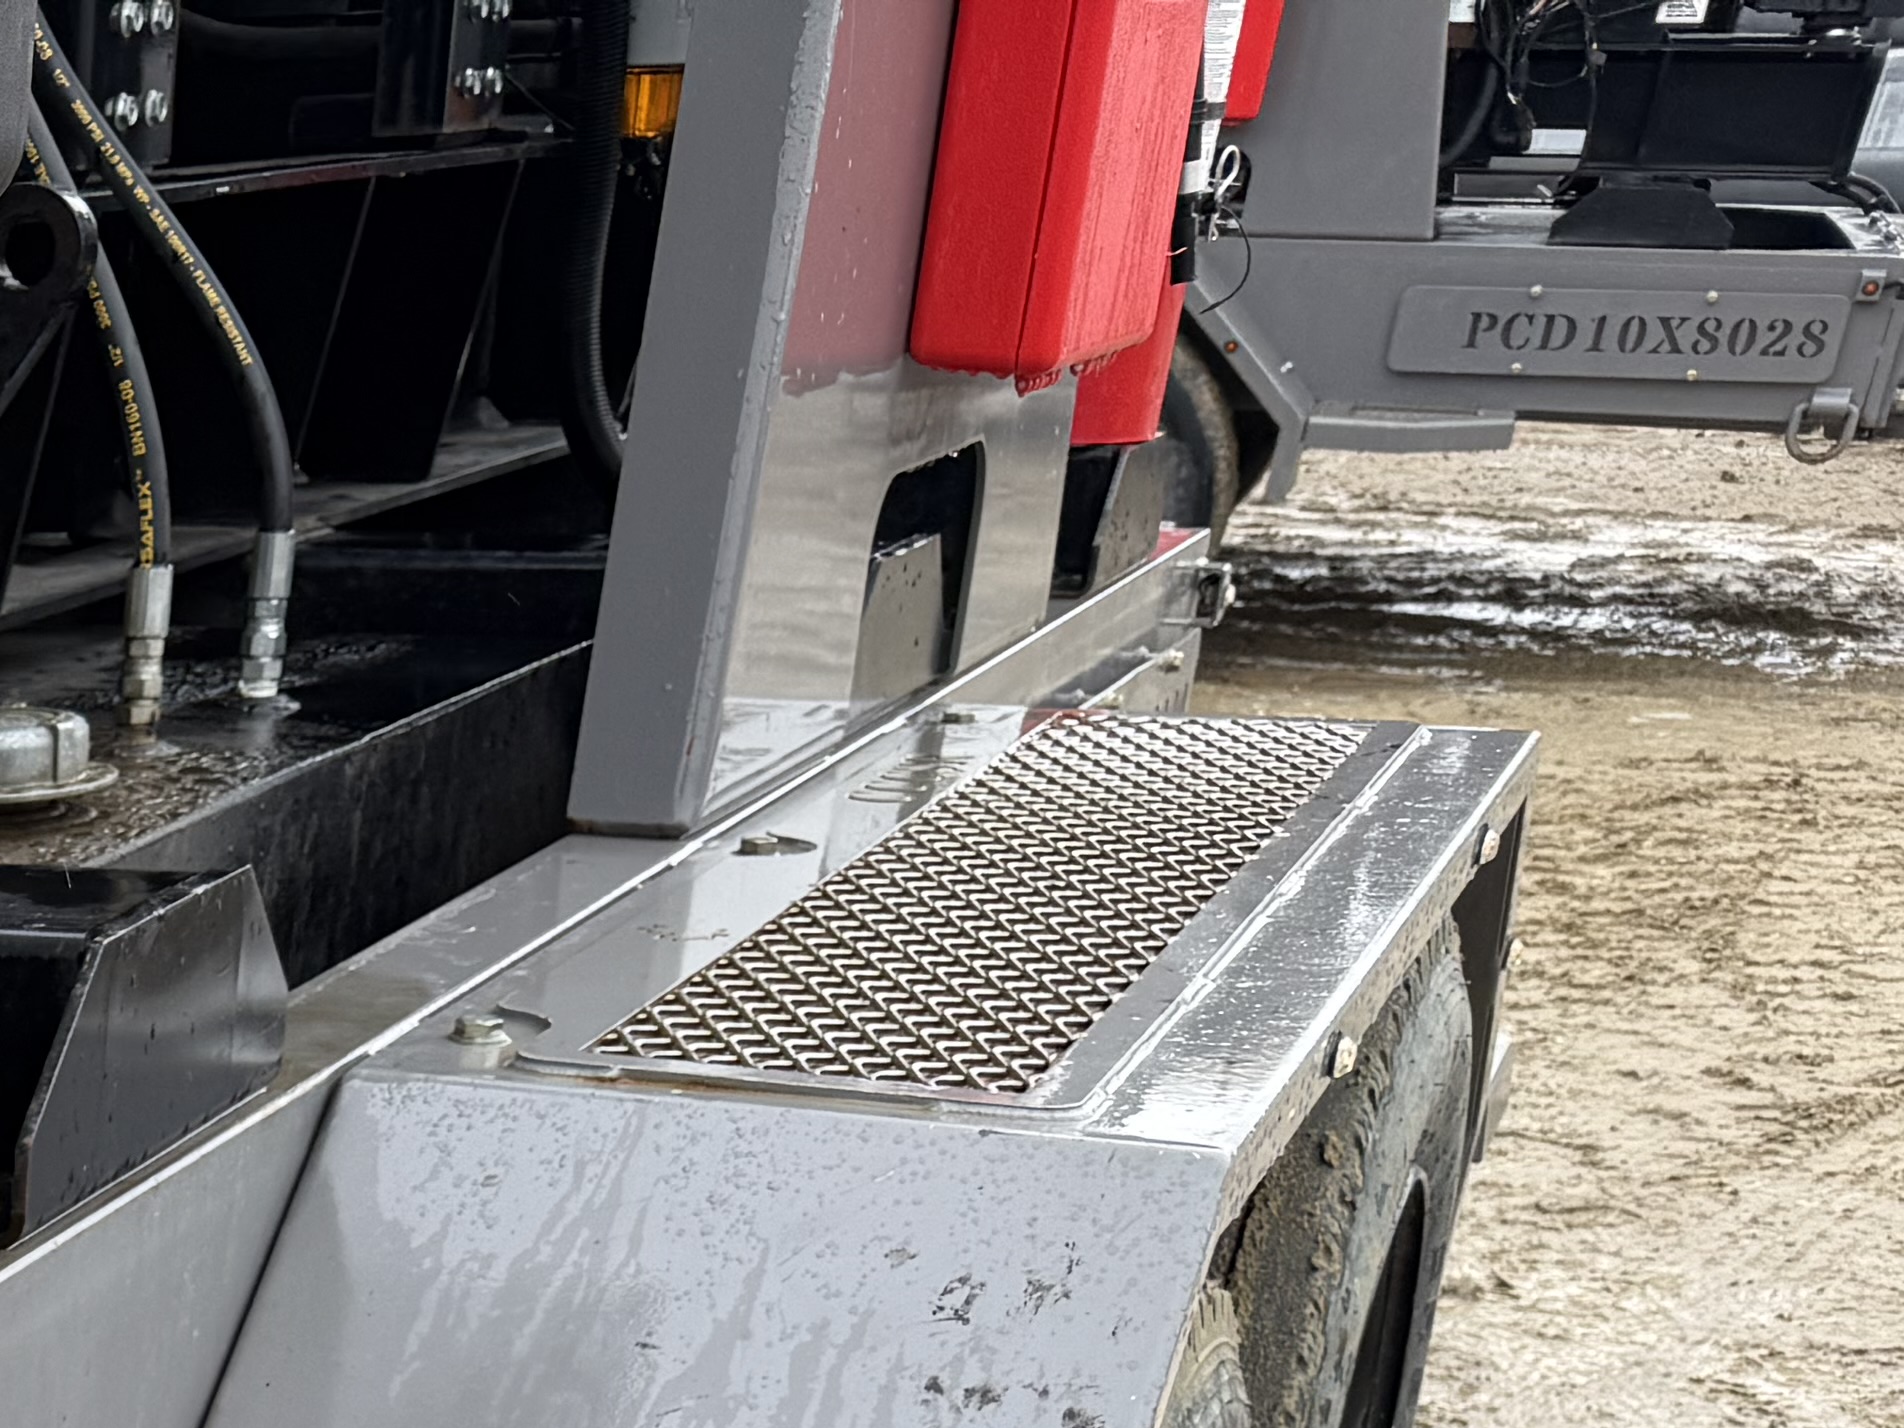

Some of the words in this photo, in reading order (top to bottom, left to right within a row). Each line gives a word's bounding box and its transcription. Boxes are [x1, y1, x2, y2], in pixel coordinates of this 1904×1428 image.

[86, 121, 106, 143] PSI
[149, 207, 171, 233] SAE
[193, 269, 222, 309] FLAME
[215, 305, 254, 367] RESISTANT
[1461, 310, 1830, 359] PCD10X8028
[118, 379, 147, 457] BN160-08
